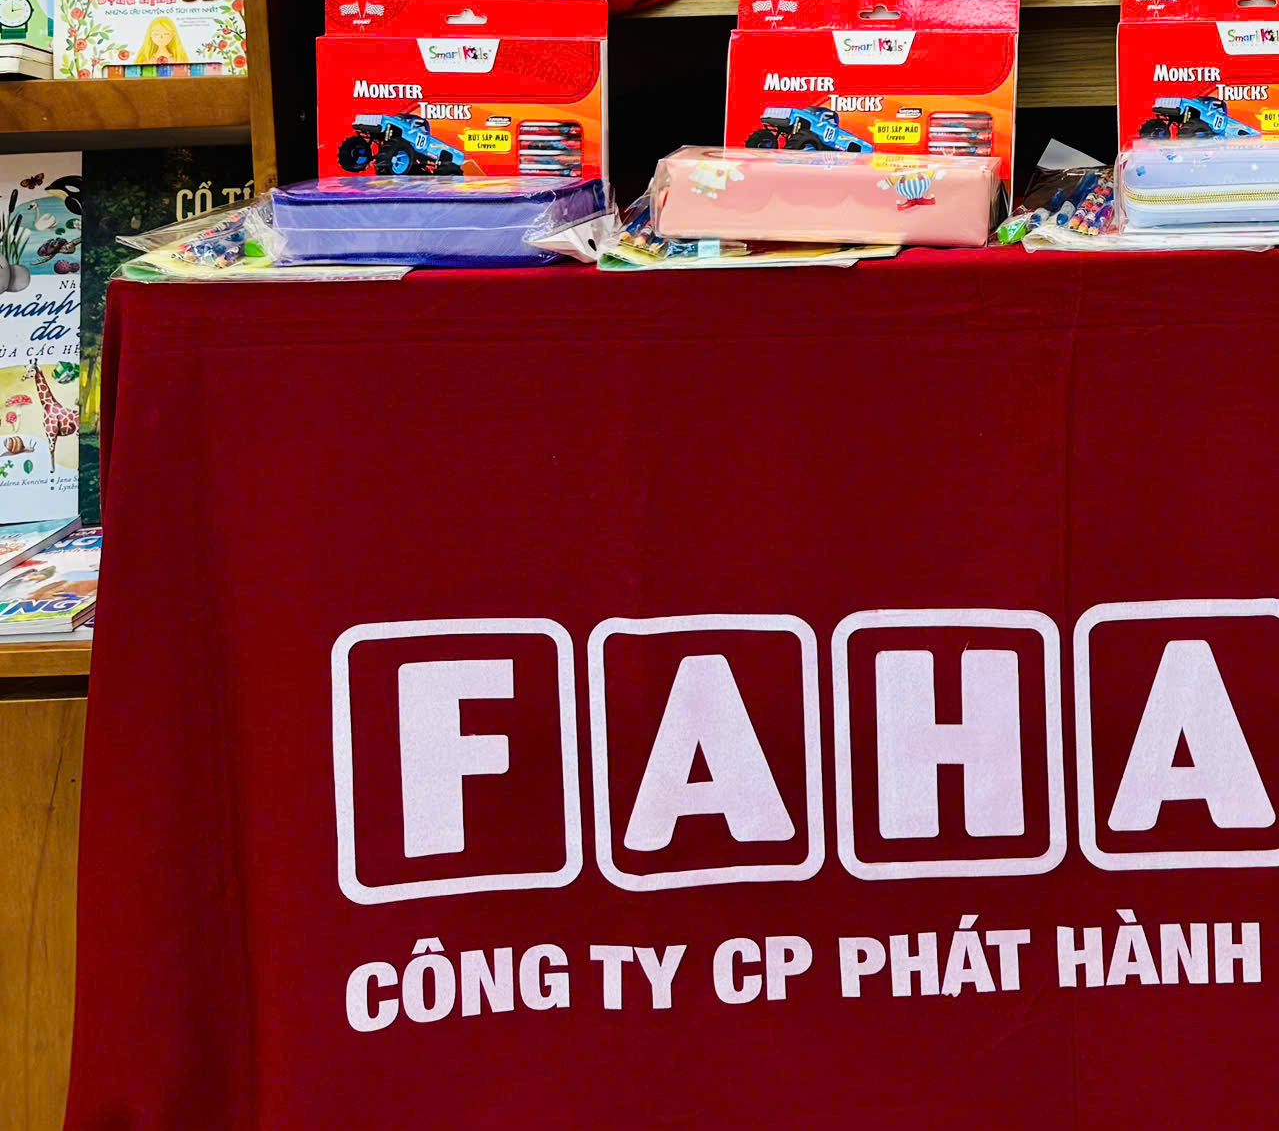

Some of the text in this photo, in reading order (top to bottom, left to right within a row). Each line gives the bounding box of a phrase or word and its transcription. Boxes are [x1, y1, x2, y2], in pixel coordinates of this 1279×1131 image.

[1153, 64, 1221, 82] MONSTER
[353, 80, 423, 99] MONSTER
[764, 73, 835, 92] MONSTER
[1216, 84, 1268, 101] TRUCKS
[417, 102, 473, 120] TRUCKS
[828, 94, 883, 112] TRUCKS
[1214, 116, 1224, 129] 18
[416, 135, 426, 148] 18
[824, 128, 835, 141] 18
[175, 180, 213, 222] CỔ
[30, 316, 71, 341] đa
[26, 343, 55, 357] CÁC
[344, 936, 571, 1034] CÔNG
[589, 940, 688, 1012] TY
[710, 935, 817, 1006] CP
[838, 912, 1033, 1000] PHÁT
[1055, 909, 1264, 989] HÀNH
